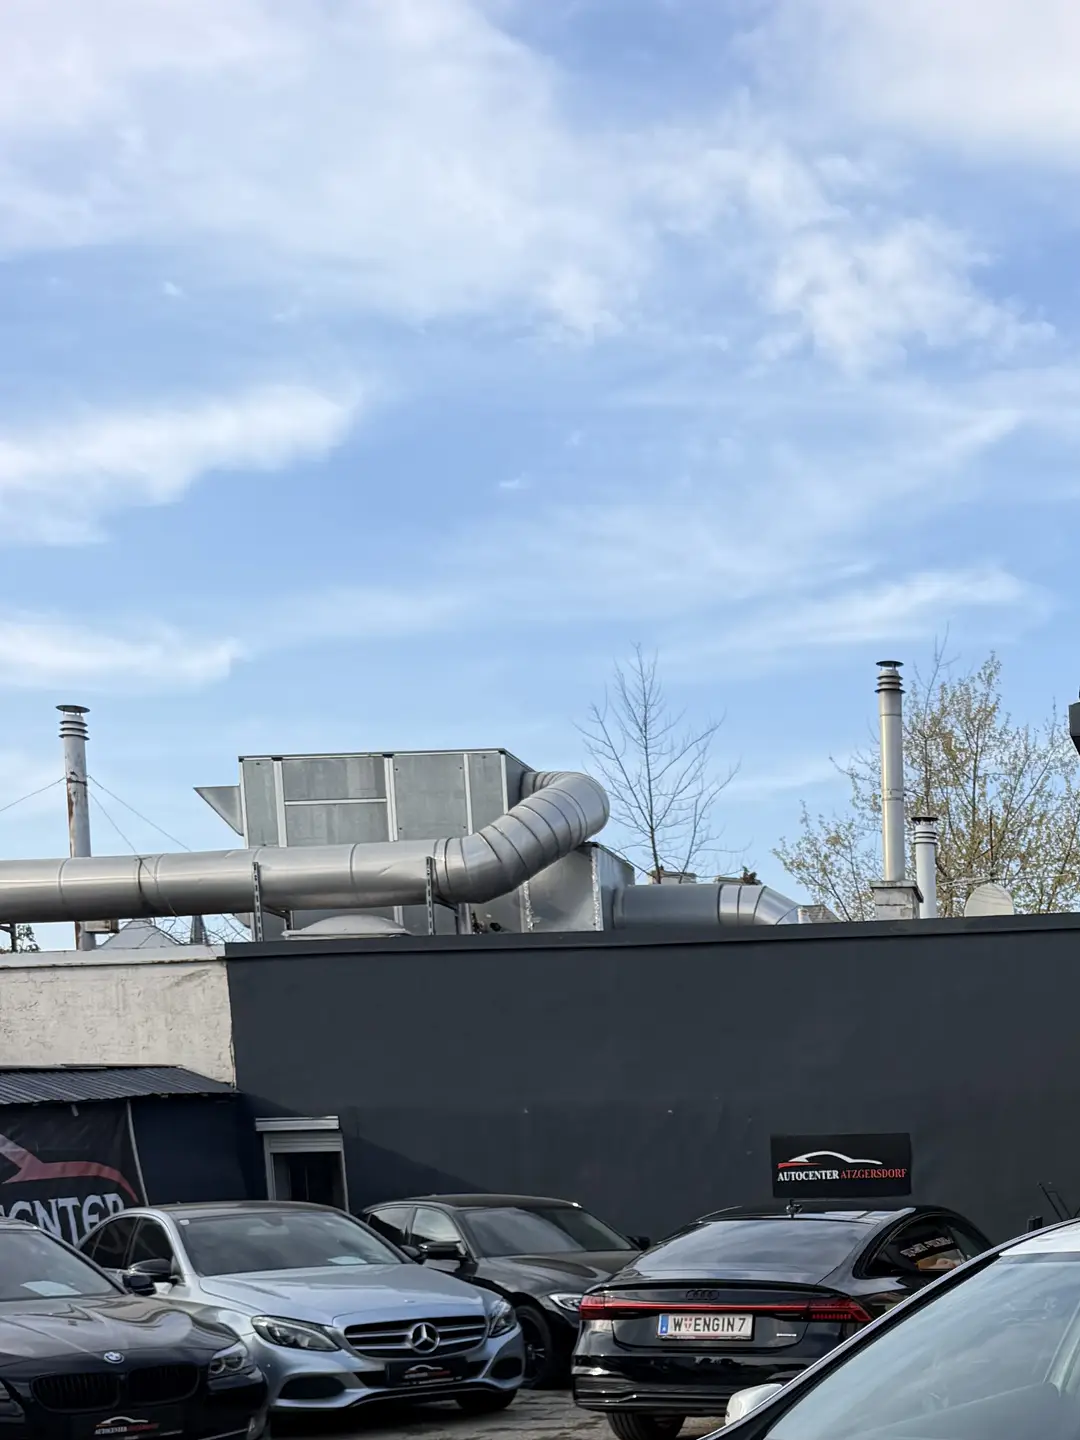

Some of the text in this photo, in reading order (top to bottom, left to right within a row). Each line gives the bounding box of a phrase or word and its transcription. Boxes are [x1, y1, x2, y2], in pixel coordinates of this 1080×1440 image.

[777, 1168, 907, 1181] AUTOCENTER ATZGERSDORF
[673, 1317, 746, 1332] W ENGIN 7
